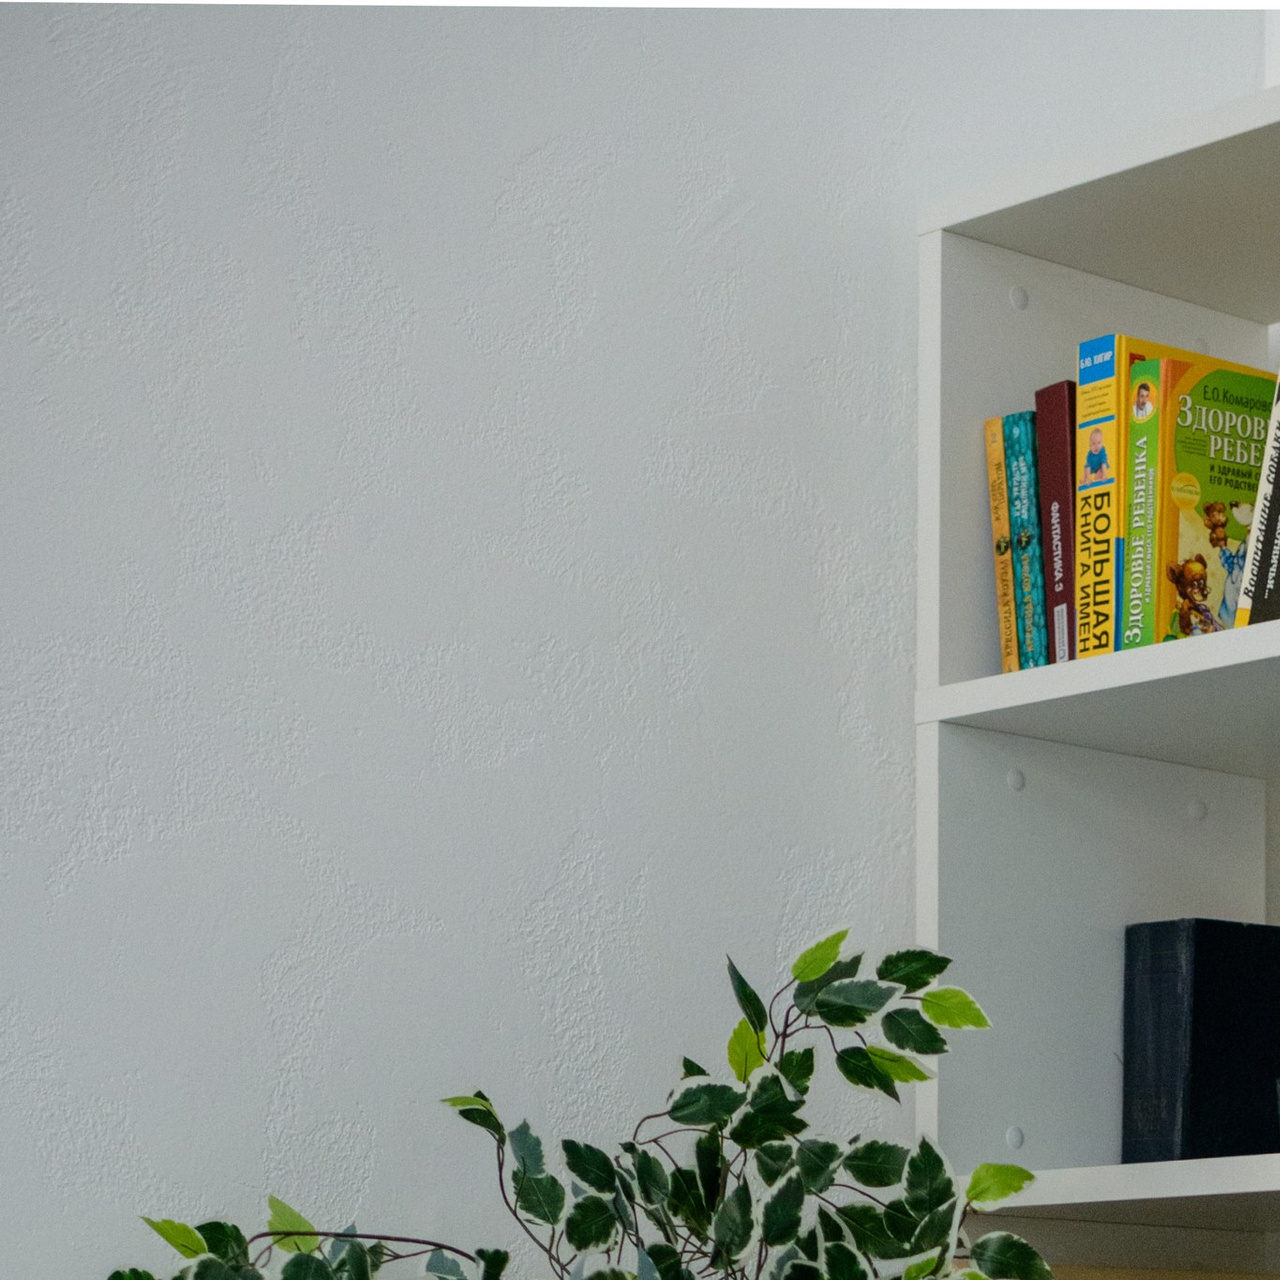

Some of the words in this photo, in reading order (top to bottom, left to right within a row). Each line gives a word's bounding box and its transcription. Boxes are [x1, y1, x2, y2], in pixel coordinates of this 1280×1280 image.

[1177, 394, 1271, 441] ЗДОРОВ
[1208, 435, 1266, 468] РЕБЕ
[1132, 436, 1148, 528] РЕБЕНКА
[1050, 501, 1064, 582] ФАНТАСТИКА
[1080, 495, 1092, 577] КНИГА
[1092, 491, 1111, 650] БОЛЬШАЯ
[1054, 582, 1064, 592] 3
[1079, 584, 1091, 653] ИМЕН
[1124, 535, 1144, 644] ЗДОРОВЬЕ
